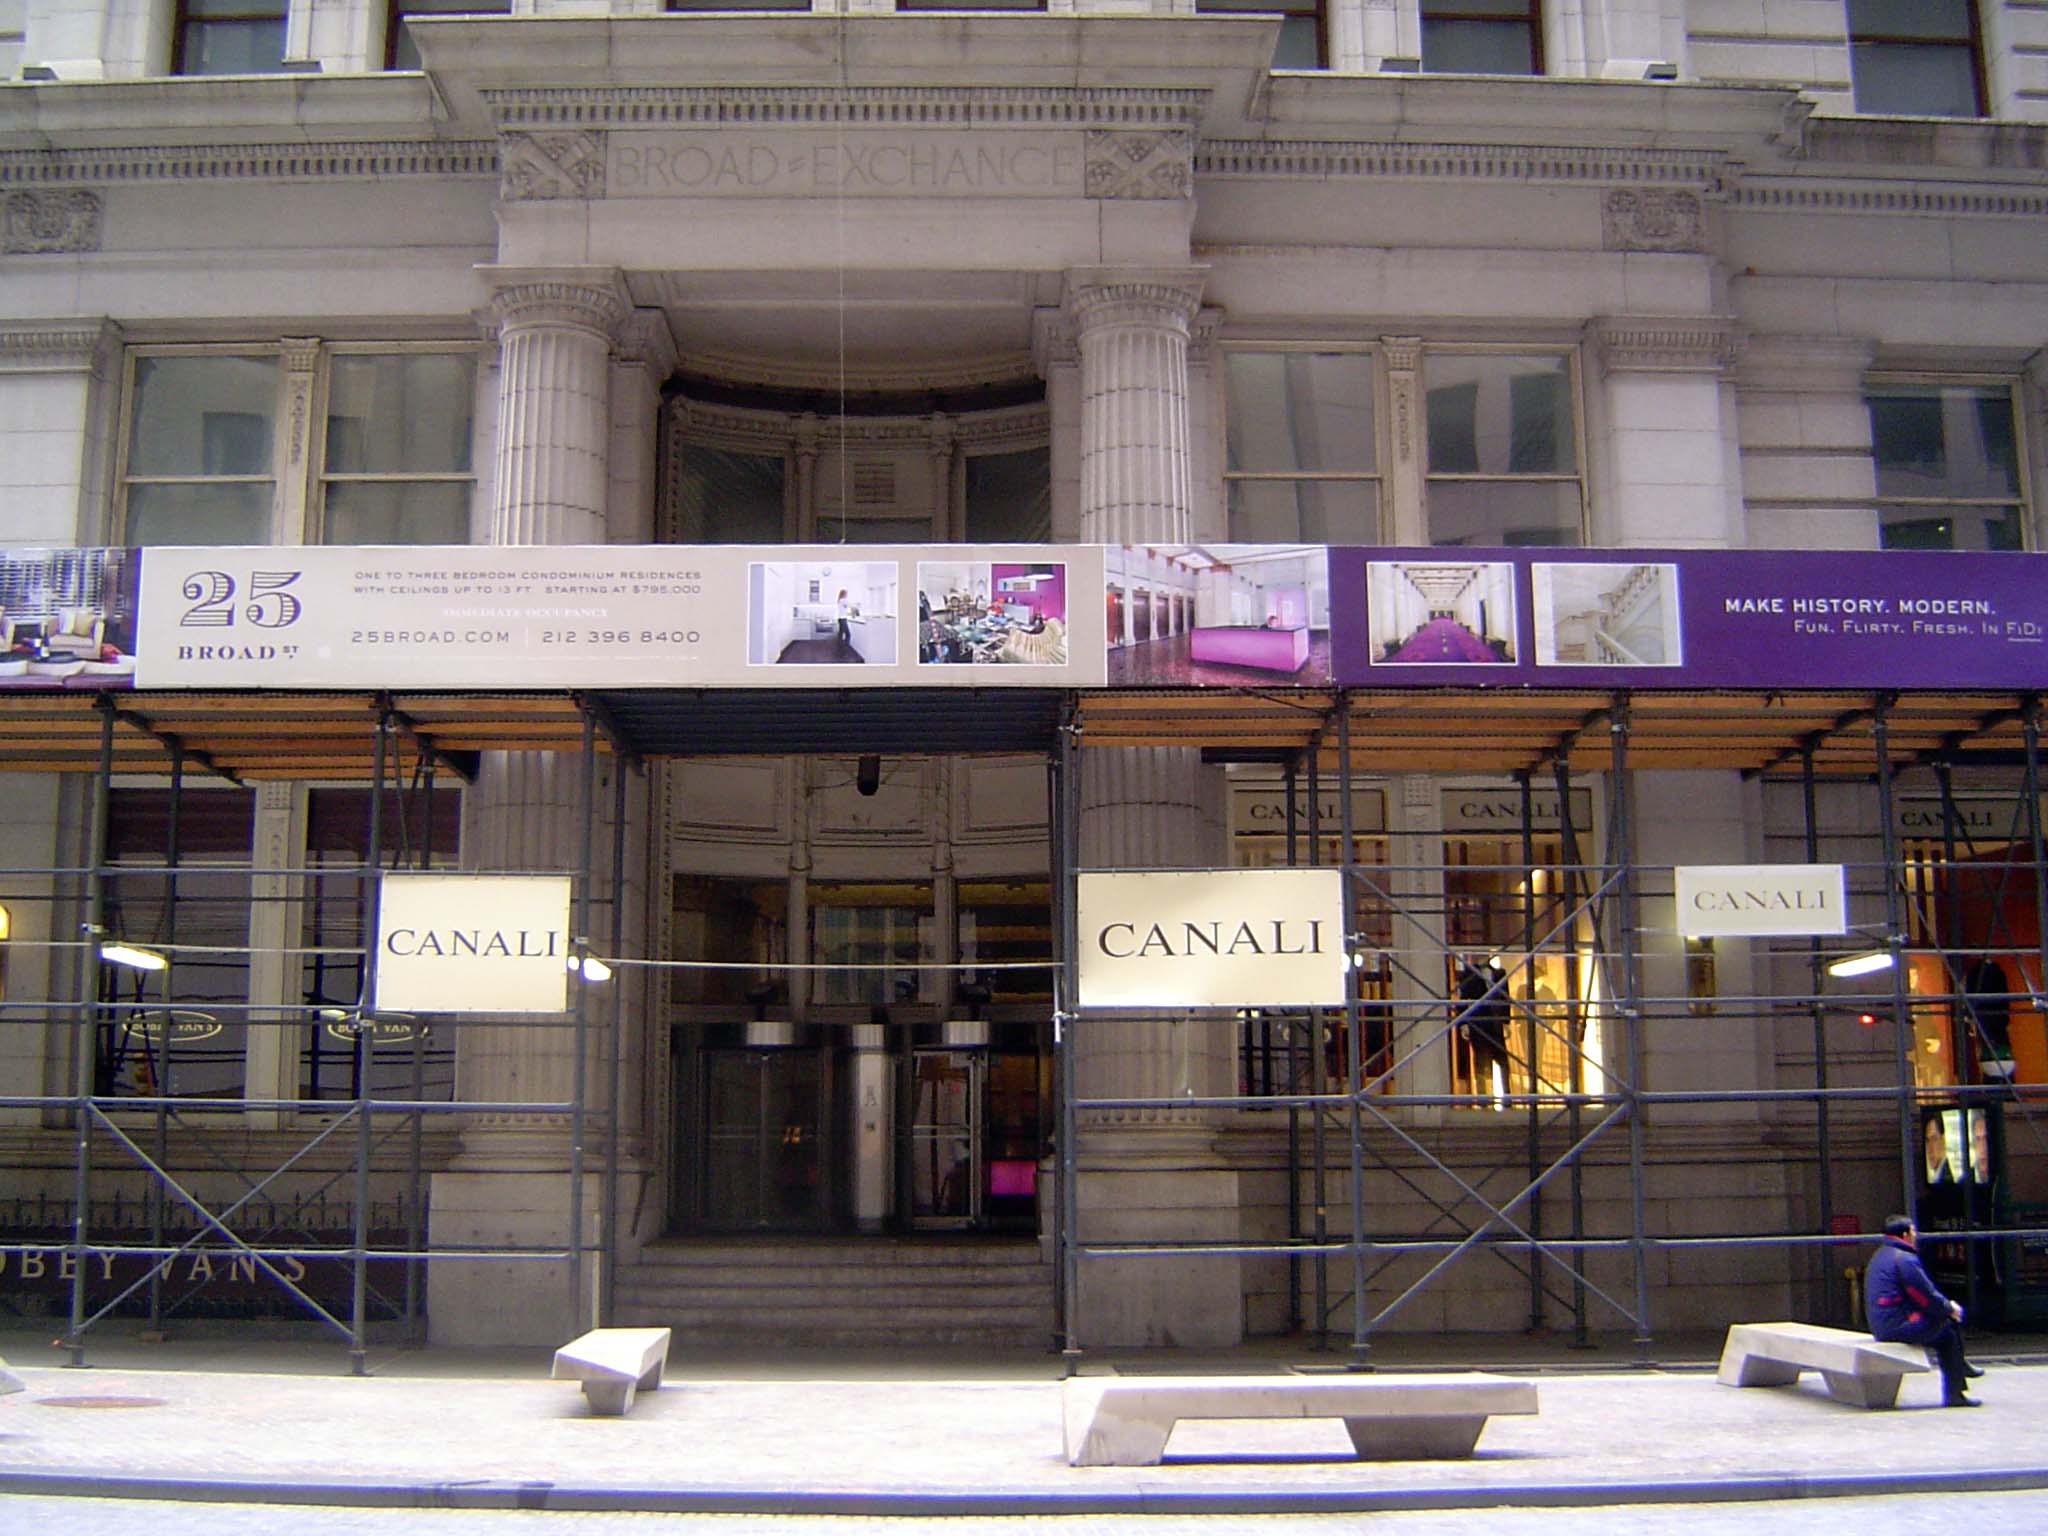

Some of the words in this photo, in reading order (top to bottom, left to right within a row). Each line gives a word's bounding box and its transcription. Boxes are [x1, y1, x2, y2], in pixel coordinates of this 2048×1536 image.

[615, 145, 778, 187] BROAD
[811, 144, 1078, 187] EXCHANGE
[354, 571, 381, 580] ONE
[387, 571, 402, 580] TO
[408, 571, 448, 580] THREE
[453, 571, 516, 580] BEDROOM
[521, 571, 615, 580] CONDOMINIUM
[620, 571, 701, 580] RESIDENCES
[354, 585, 385, 594] WITH
[390, 585, 449, 594] CEILINGS
[454, 585, 471, 594] UP
[477, 585, 492, 594] TO
[545, 585, 607, 594] STARTING
[612, 585, 627, 594] AT
[179, 570, 303, 628] 25
[1725, 598, 1783, 614] MAKE
[1793, 598, 1890, 614] HISTORY.
[1900, 599, 1997, 615] MODERN.
[1982, 621, 1998, 635] IN
[352, 631, 510, 644] 25BROAD.COM
[542, 631, 578, 644] 212
[587, 631, 631, 644] 396
[640, 631, 702, 644] 8400
[177, 645, 276, 661] BROAD
[1250, 803, 1344, 820] CANL
[1460, 802, 1560, 818] CANLI
[1694, 889, 1826, 911] CANALI
[387, 928, 560, 957] CANALI
[1098, 920, 1325, 958] CANALI
